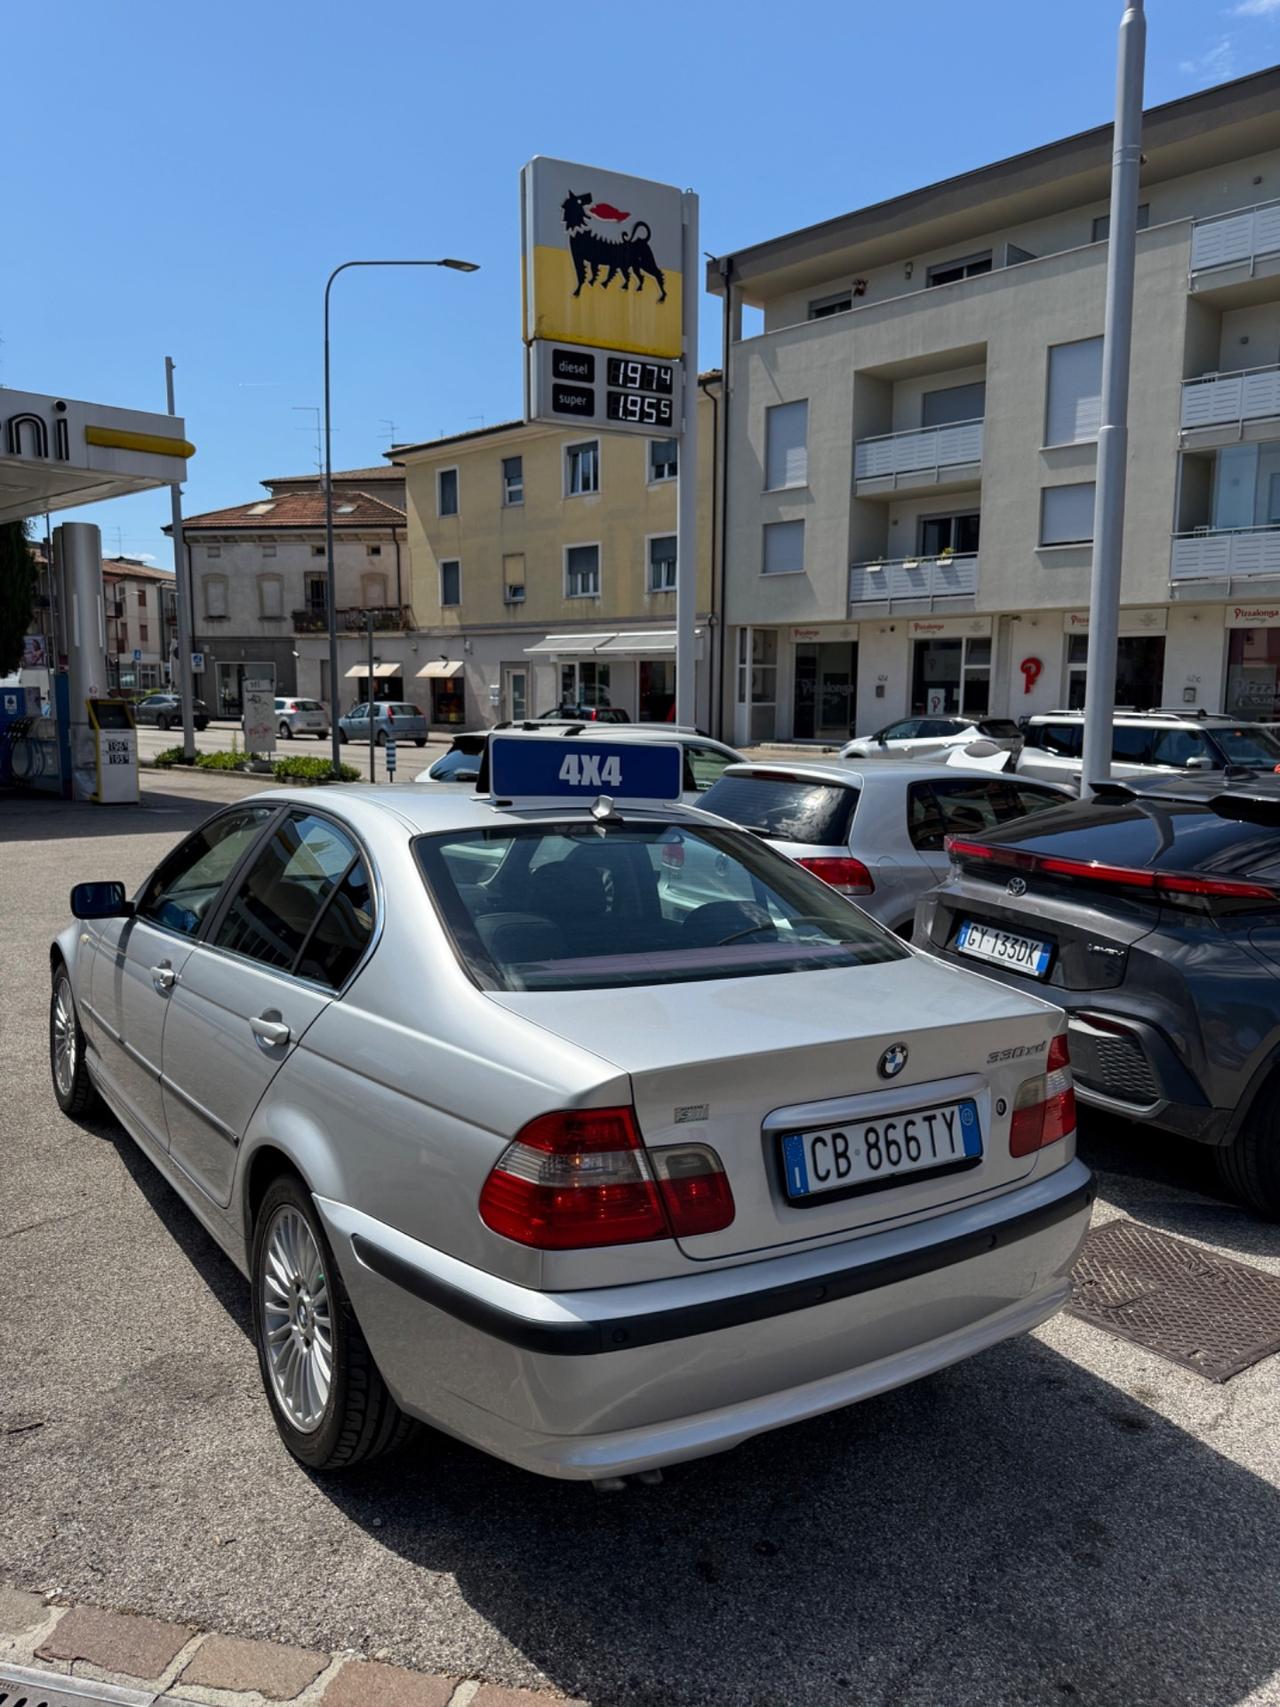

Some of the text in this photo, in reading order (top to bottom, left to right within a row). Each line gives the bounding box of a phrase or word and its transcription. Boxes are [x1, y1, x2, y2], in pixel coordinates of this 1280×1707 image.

[559, 361, 588, 375] diesel
[559, 393, 587, 408] super
[0, 400, 69, 461] ni
[559, 754, 622, 786] 4X4
[991, 932, 1039, 967] 133DK
[811, 1109, 956, 1182] CB 866TY
